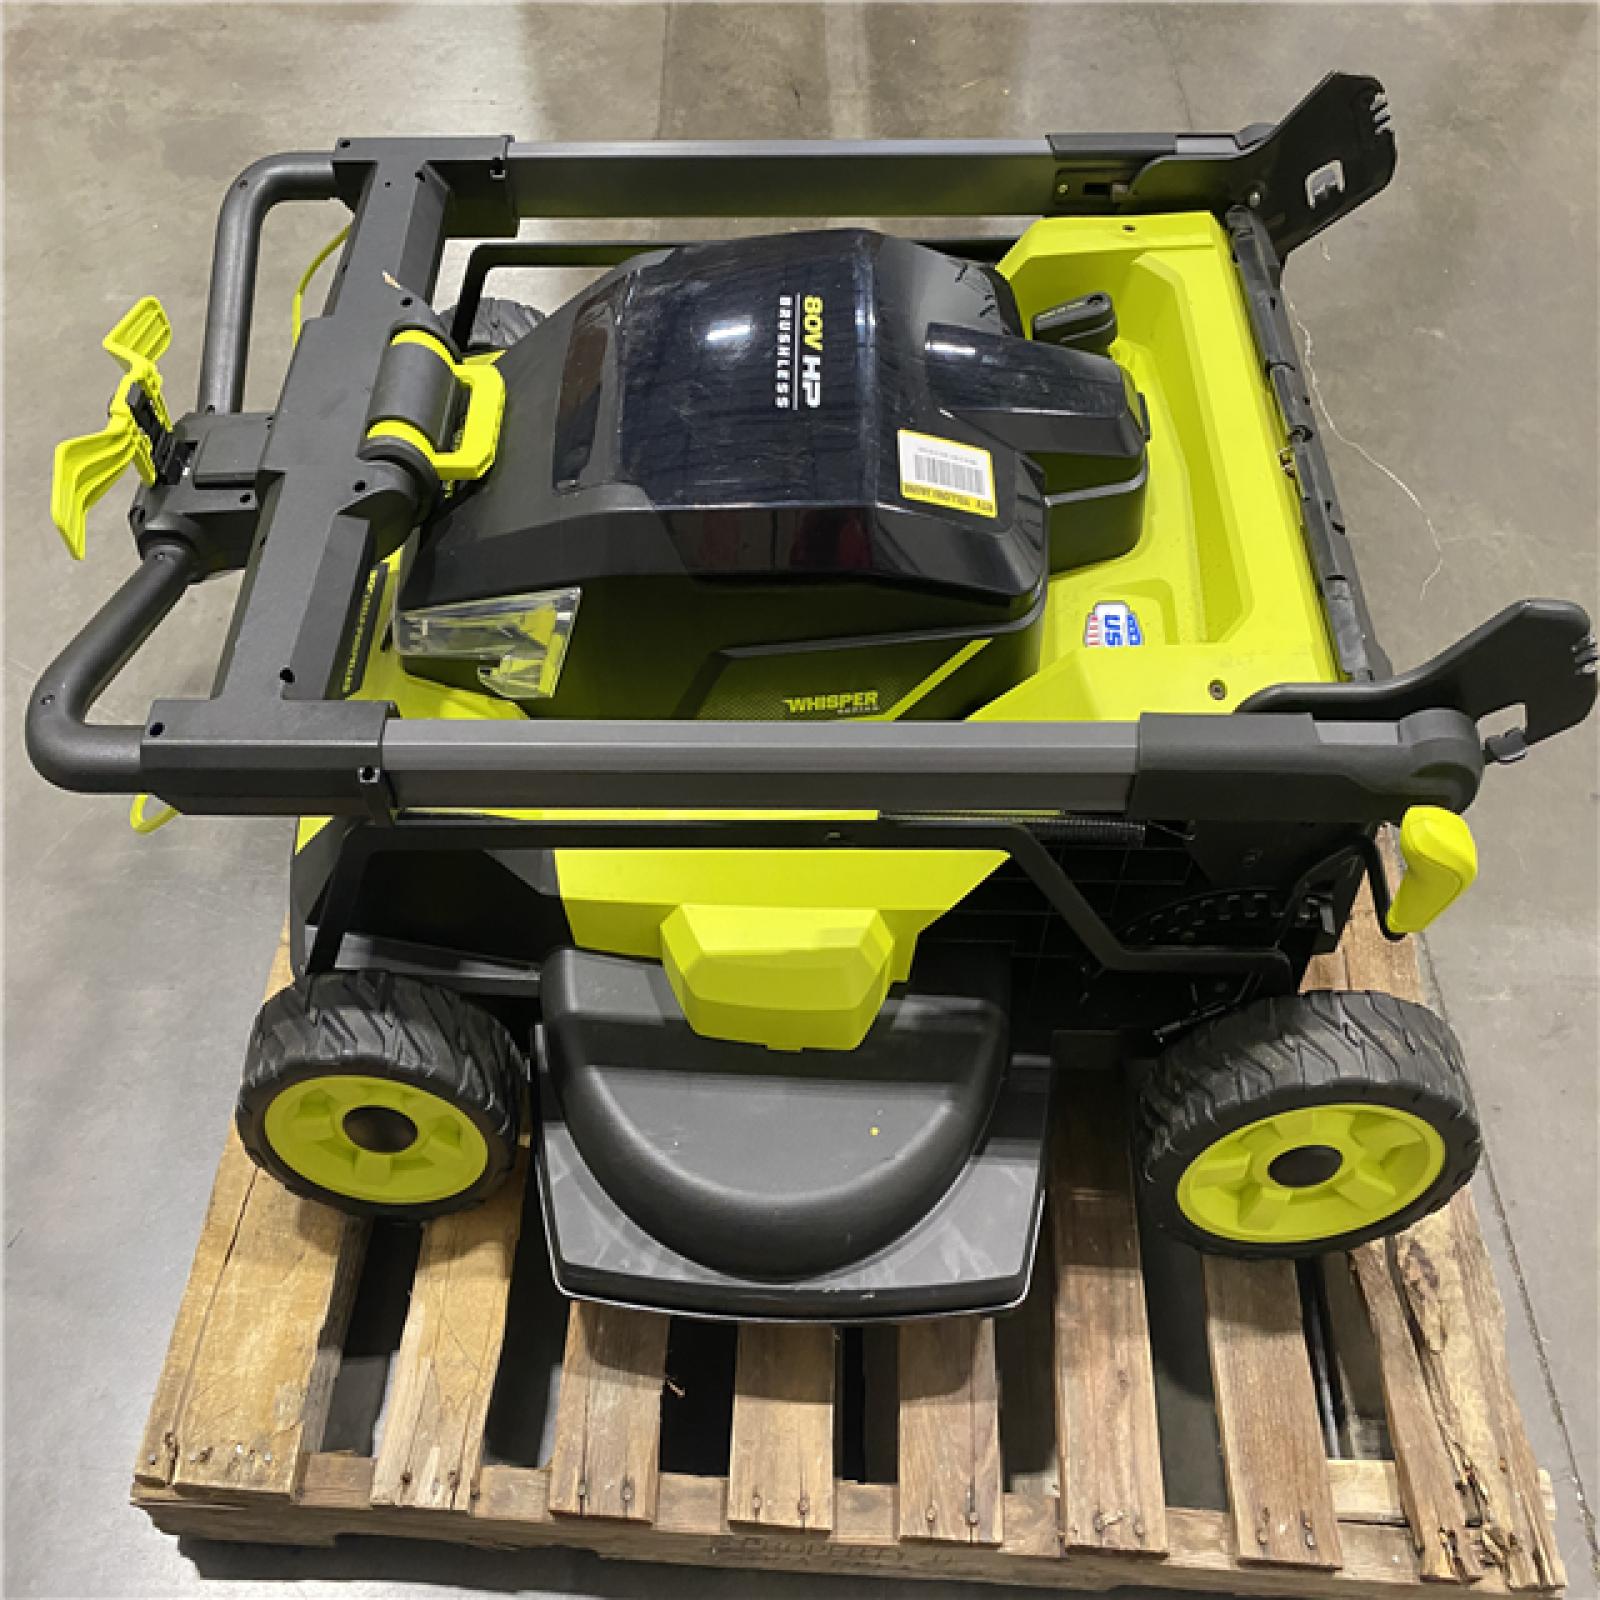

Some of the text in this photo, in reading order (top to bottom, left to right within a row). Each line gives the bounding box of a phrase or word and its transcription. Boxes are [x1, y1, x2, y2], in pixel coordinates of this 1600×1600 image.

[776, 296, 792, 408] BRUSHLESS
[802, 296, 824, 408] 80V HP
[782, 690, 879, 713] WHISPER
